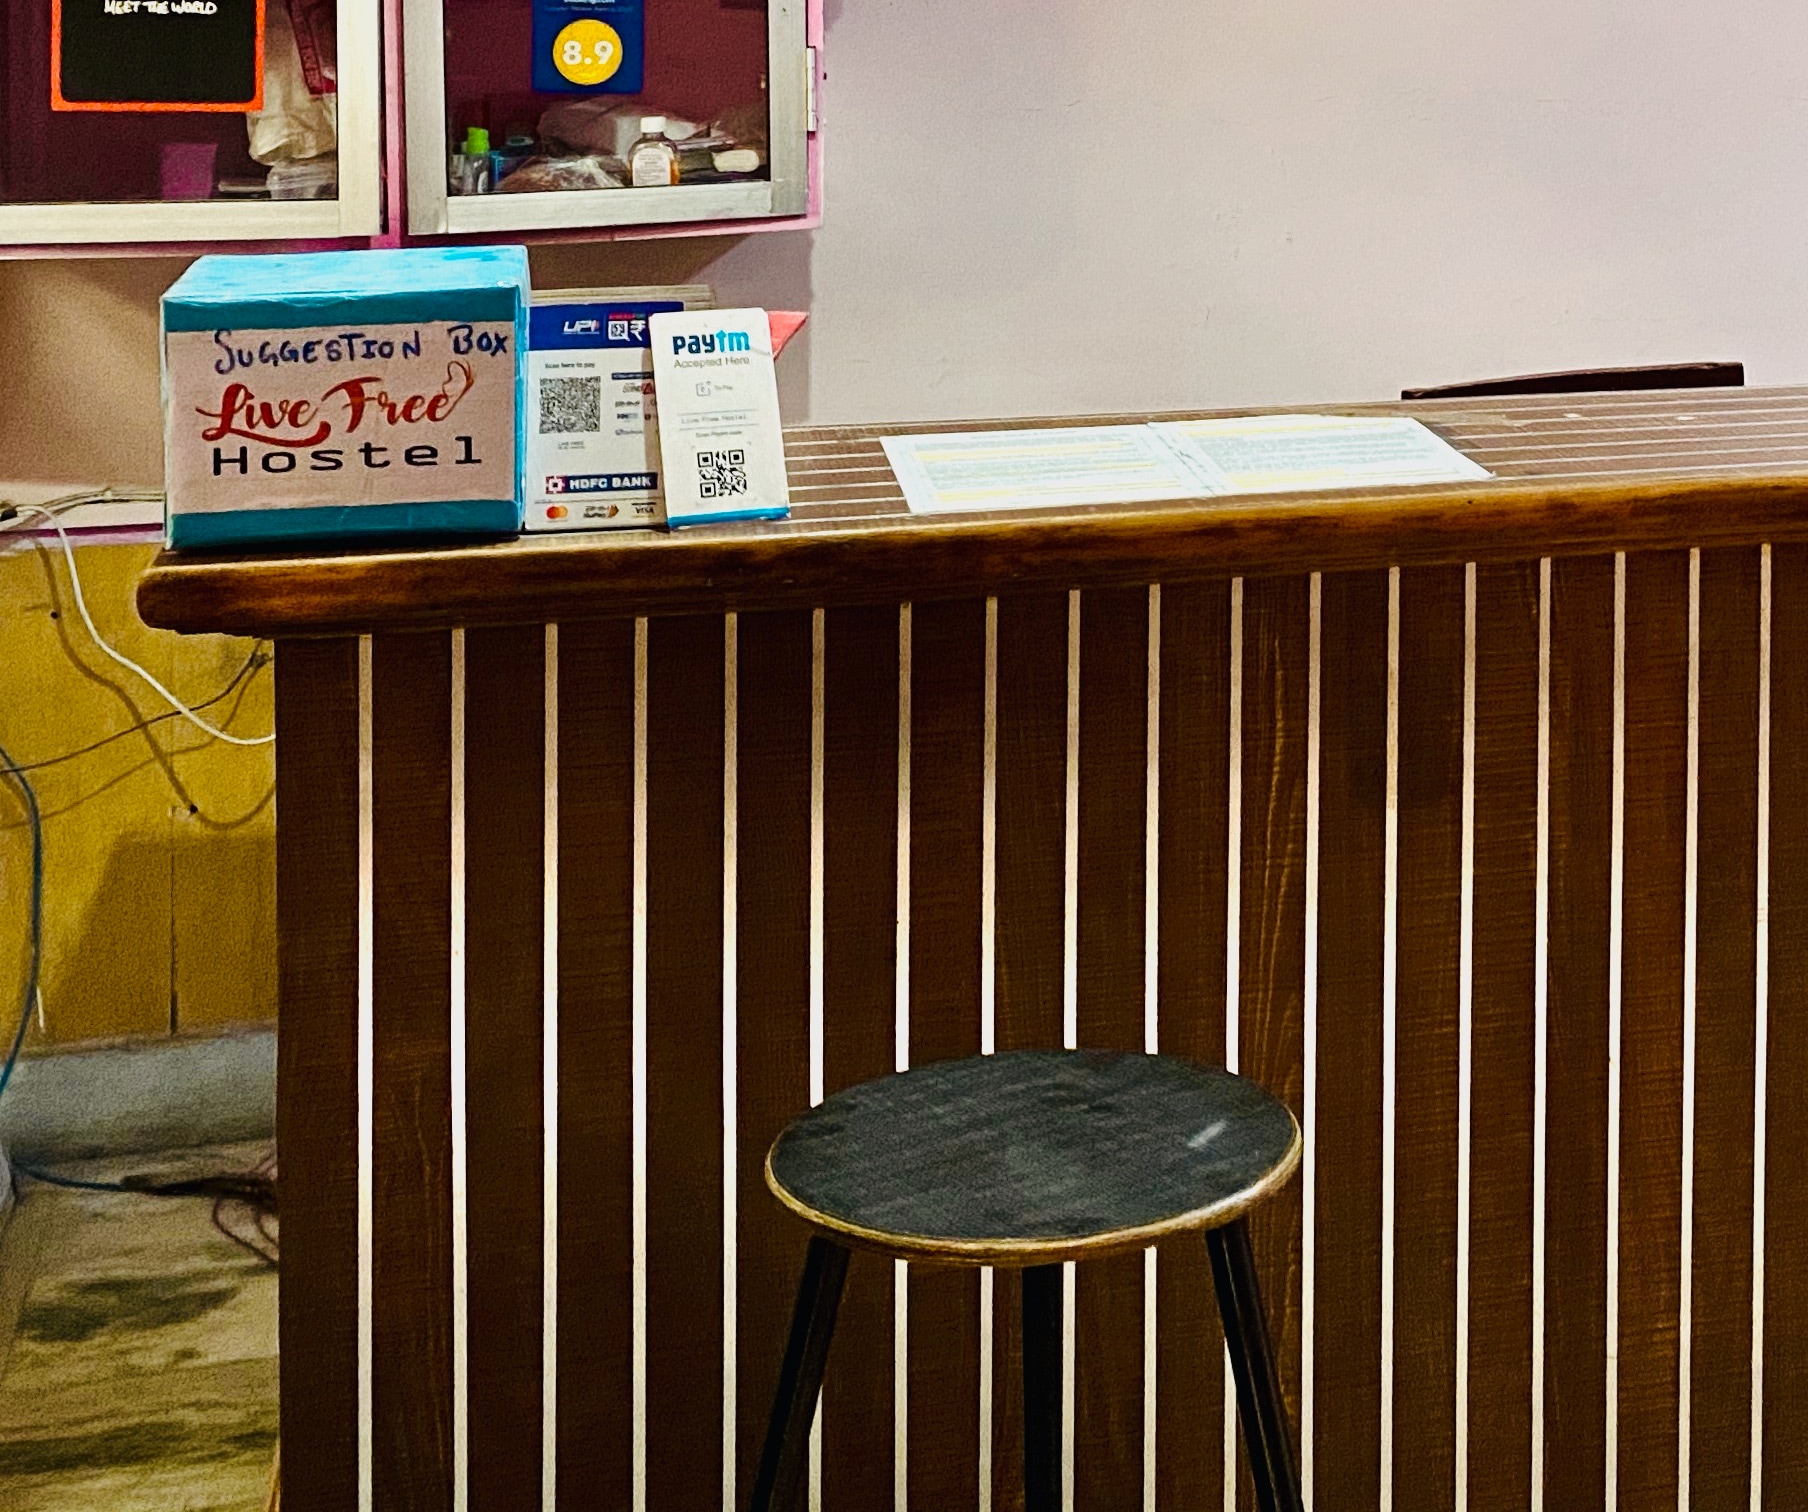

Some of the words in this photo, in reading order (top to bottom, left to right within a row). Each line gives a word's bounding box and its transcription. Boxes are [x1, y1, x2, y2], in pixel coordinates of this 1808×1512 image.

[104, 0, 141, 14] MEET
[171, 0, 218, 15] WORLD
[562, 40, 613, 65] 8.9
[564, 320, 597, 333] UPI
[672, 330, 750, 355] paytm
[674, 358, 722, 368] Accepted
[725, 357, 750, 365] Here
[196, 382, 332, 448] Live
[322, 369, 467, 433] Free
[212, 436, 482, 476] Hostel
[570, 478, 608, 490] HDFC
[612, 476, 651, 488] BANK
